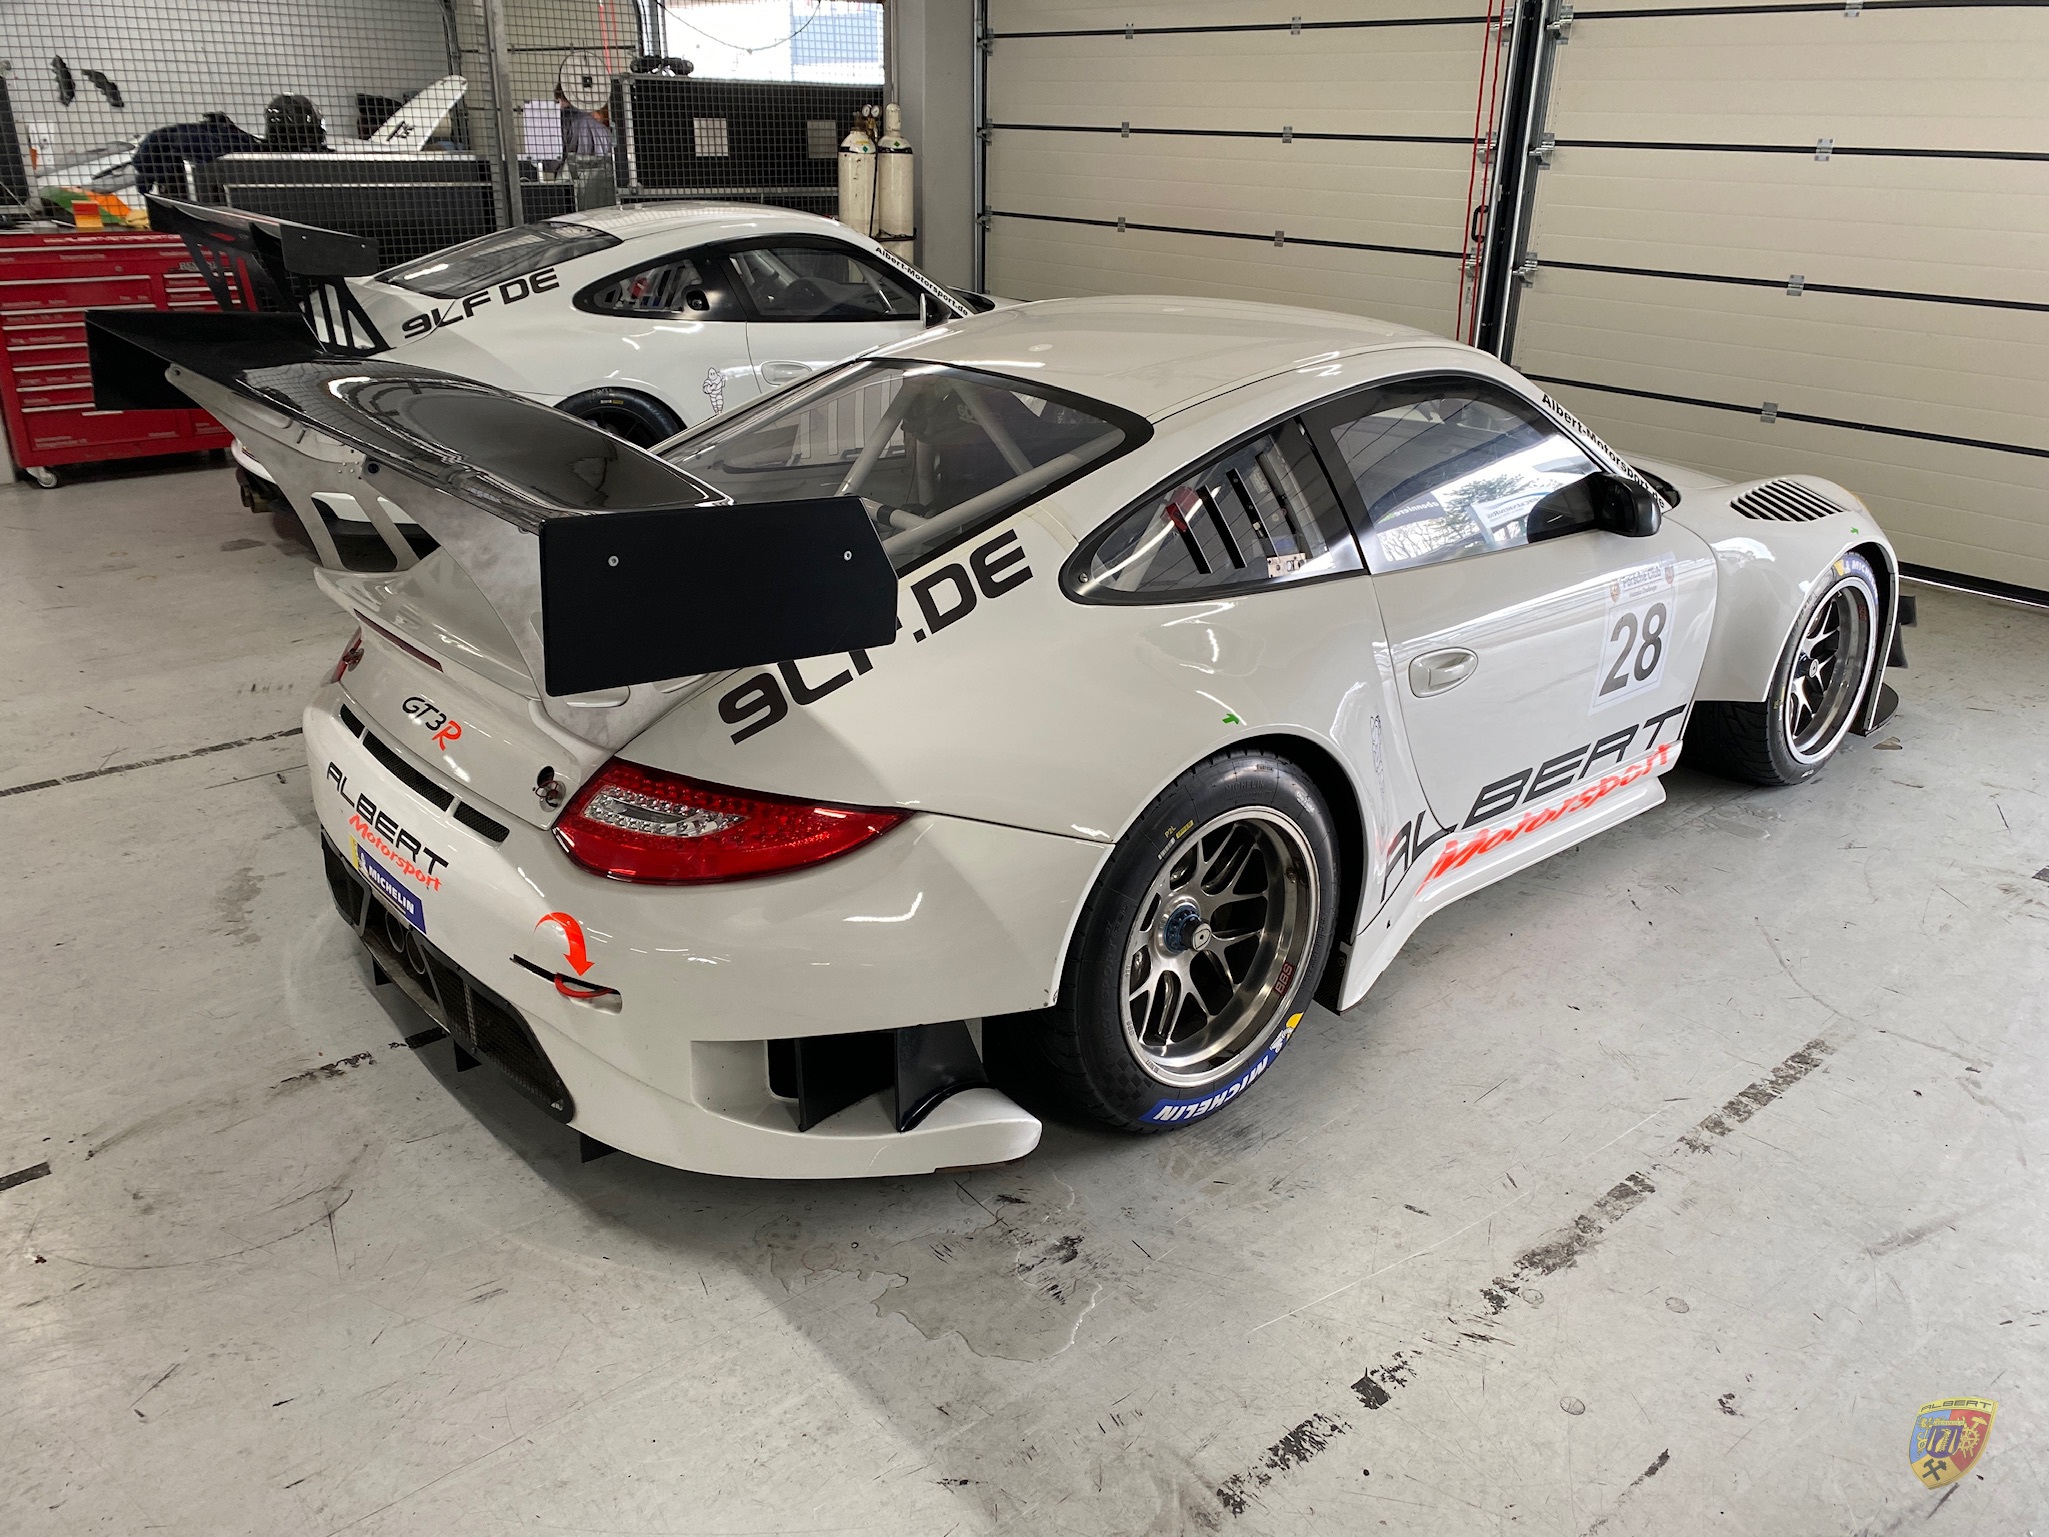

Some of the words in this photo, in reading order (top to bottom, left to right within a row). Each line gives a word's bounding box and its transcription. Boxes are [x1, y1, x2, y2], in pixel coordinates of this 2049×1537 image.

[402, 290, 492, 339] 9LF
[498, 267, 560, 305] DE
[875, 246, 969, 316] Albert-Motorsport.de
[717, 528, 1034, 745] 9L.DE
[1599, 602, 1667, 697] 28
[327, 761, 450, 876] ALBERT
[1380, 703, 1688, 904] ALBERT
[1415, 742, 1672, 896] Motorsport
[348, 812, 443, 892] Motorsport
[367, 864, 415, 916] MICHELIN
[1274, 963, 1294, 996] BBS
[1153, 1054, 1269, 1121] MICHELIN
